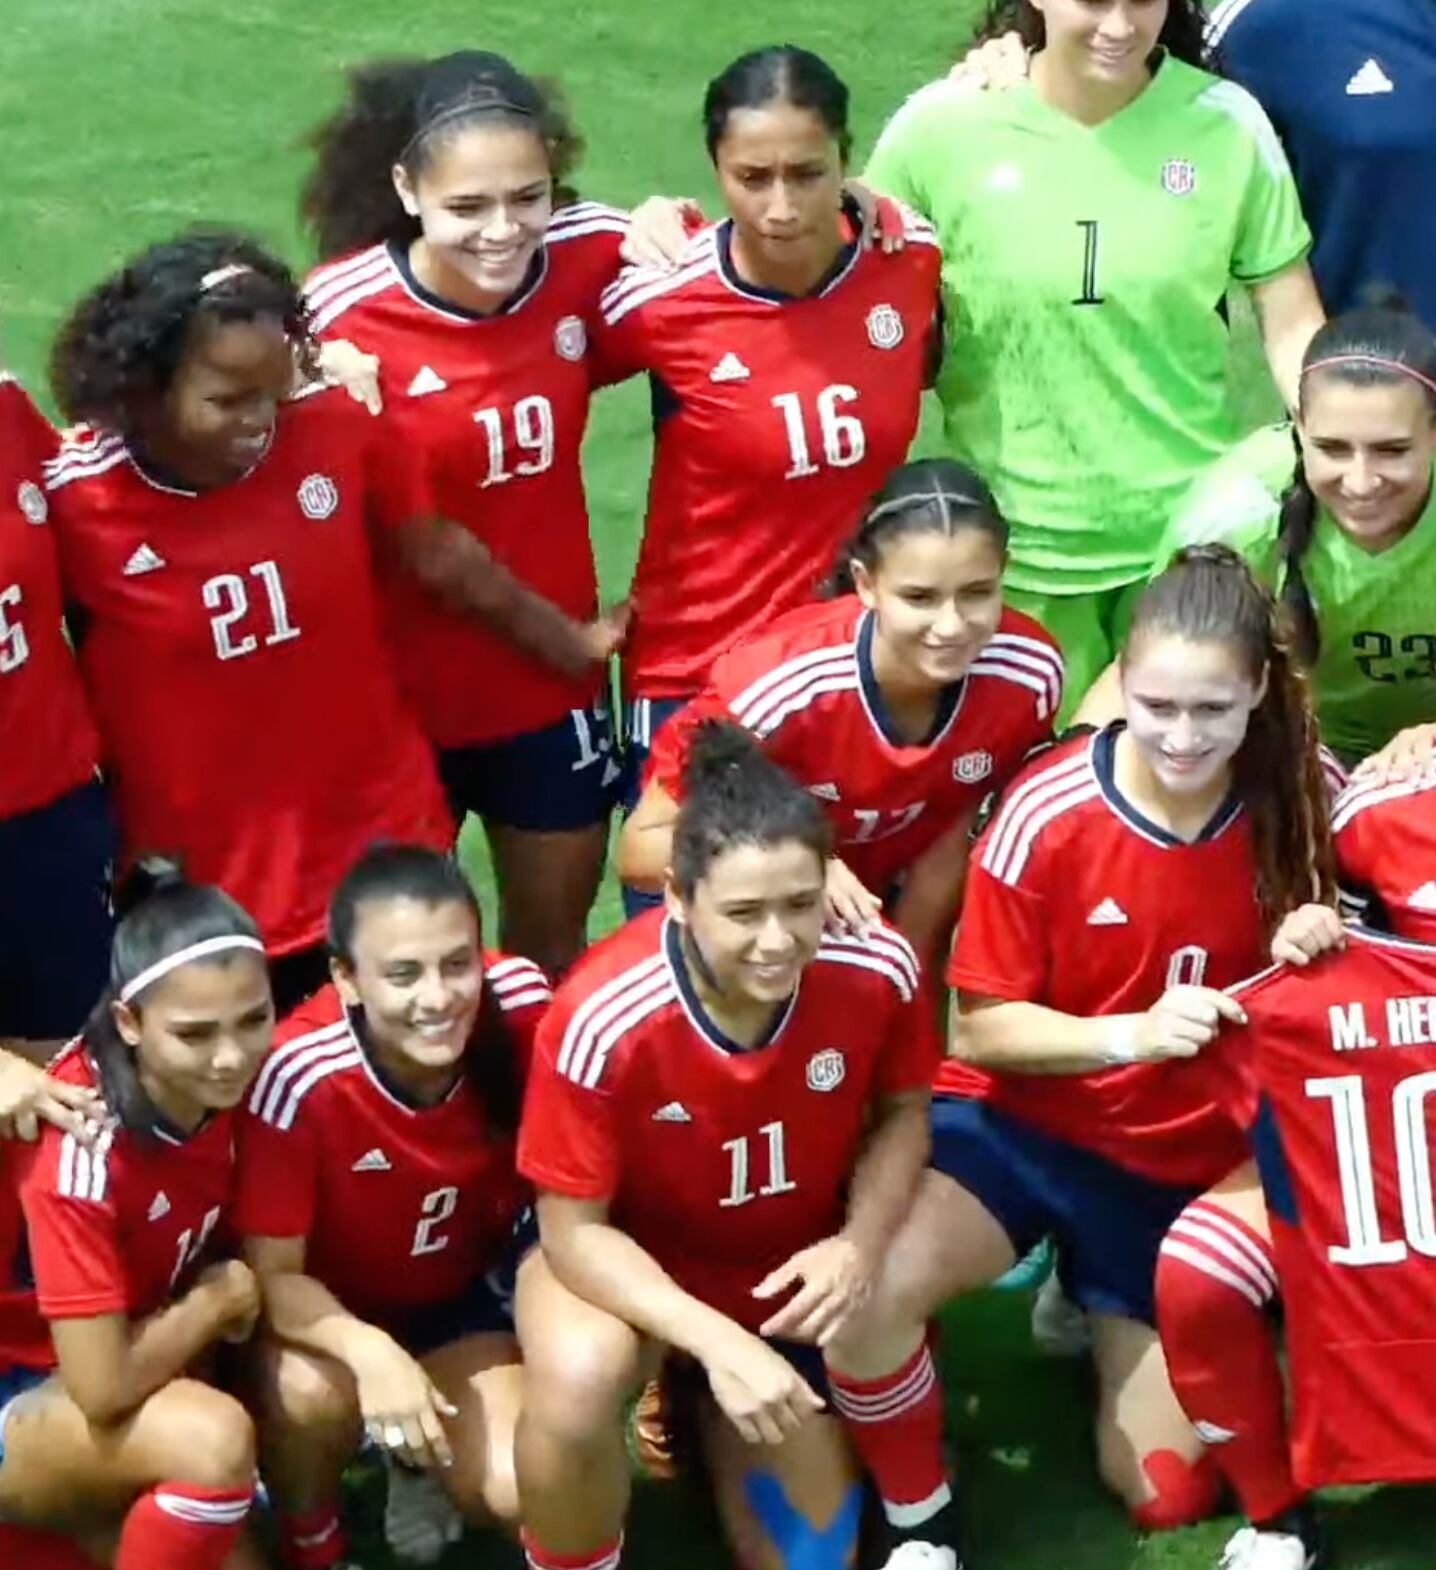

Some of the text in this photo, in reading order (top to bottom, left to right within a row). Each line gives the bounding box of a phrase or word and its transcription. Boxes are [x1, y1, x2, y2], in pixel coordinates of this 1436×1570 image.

[1072, 220, 1105, 305] 1
[473, 395, 554, 488] 19
[772, 384, 865, 479] 16
[203, 560, 300, 660] 21
[1328, 1002, 1378, 1051] M.
[719, 1121, 797, 1206] 11
[410, 1187, 459, 1256] 2
